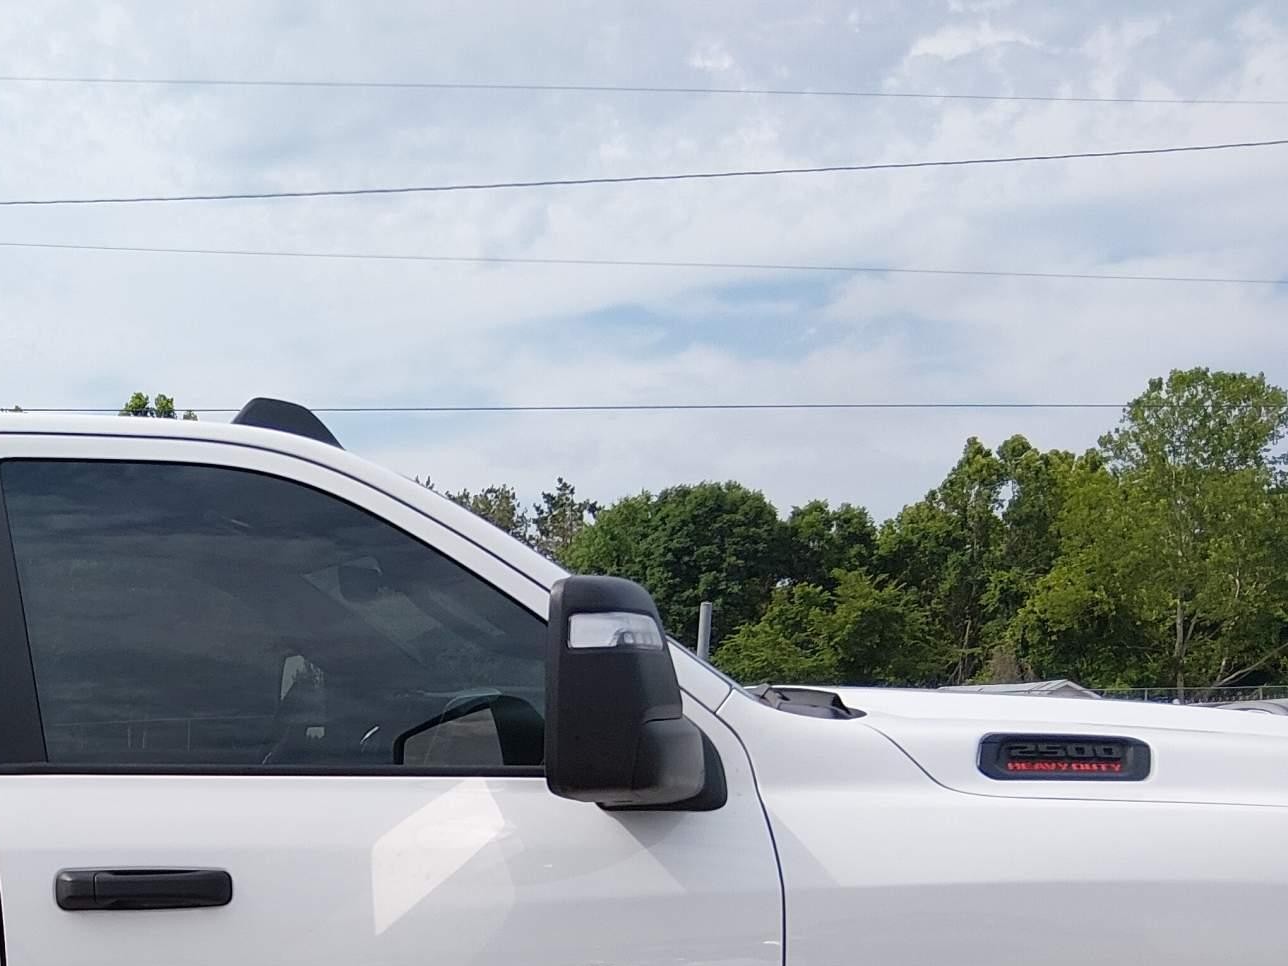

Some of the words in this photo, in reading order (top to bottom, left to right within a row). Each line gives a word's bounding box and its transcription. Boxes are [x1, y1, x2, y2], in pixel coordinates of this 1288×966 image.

[1010, 743, 1120, 757] 2500
[1007, 761, 1069, 771] HEAVY
[1071, 762, 1121, 772] DUTY
